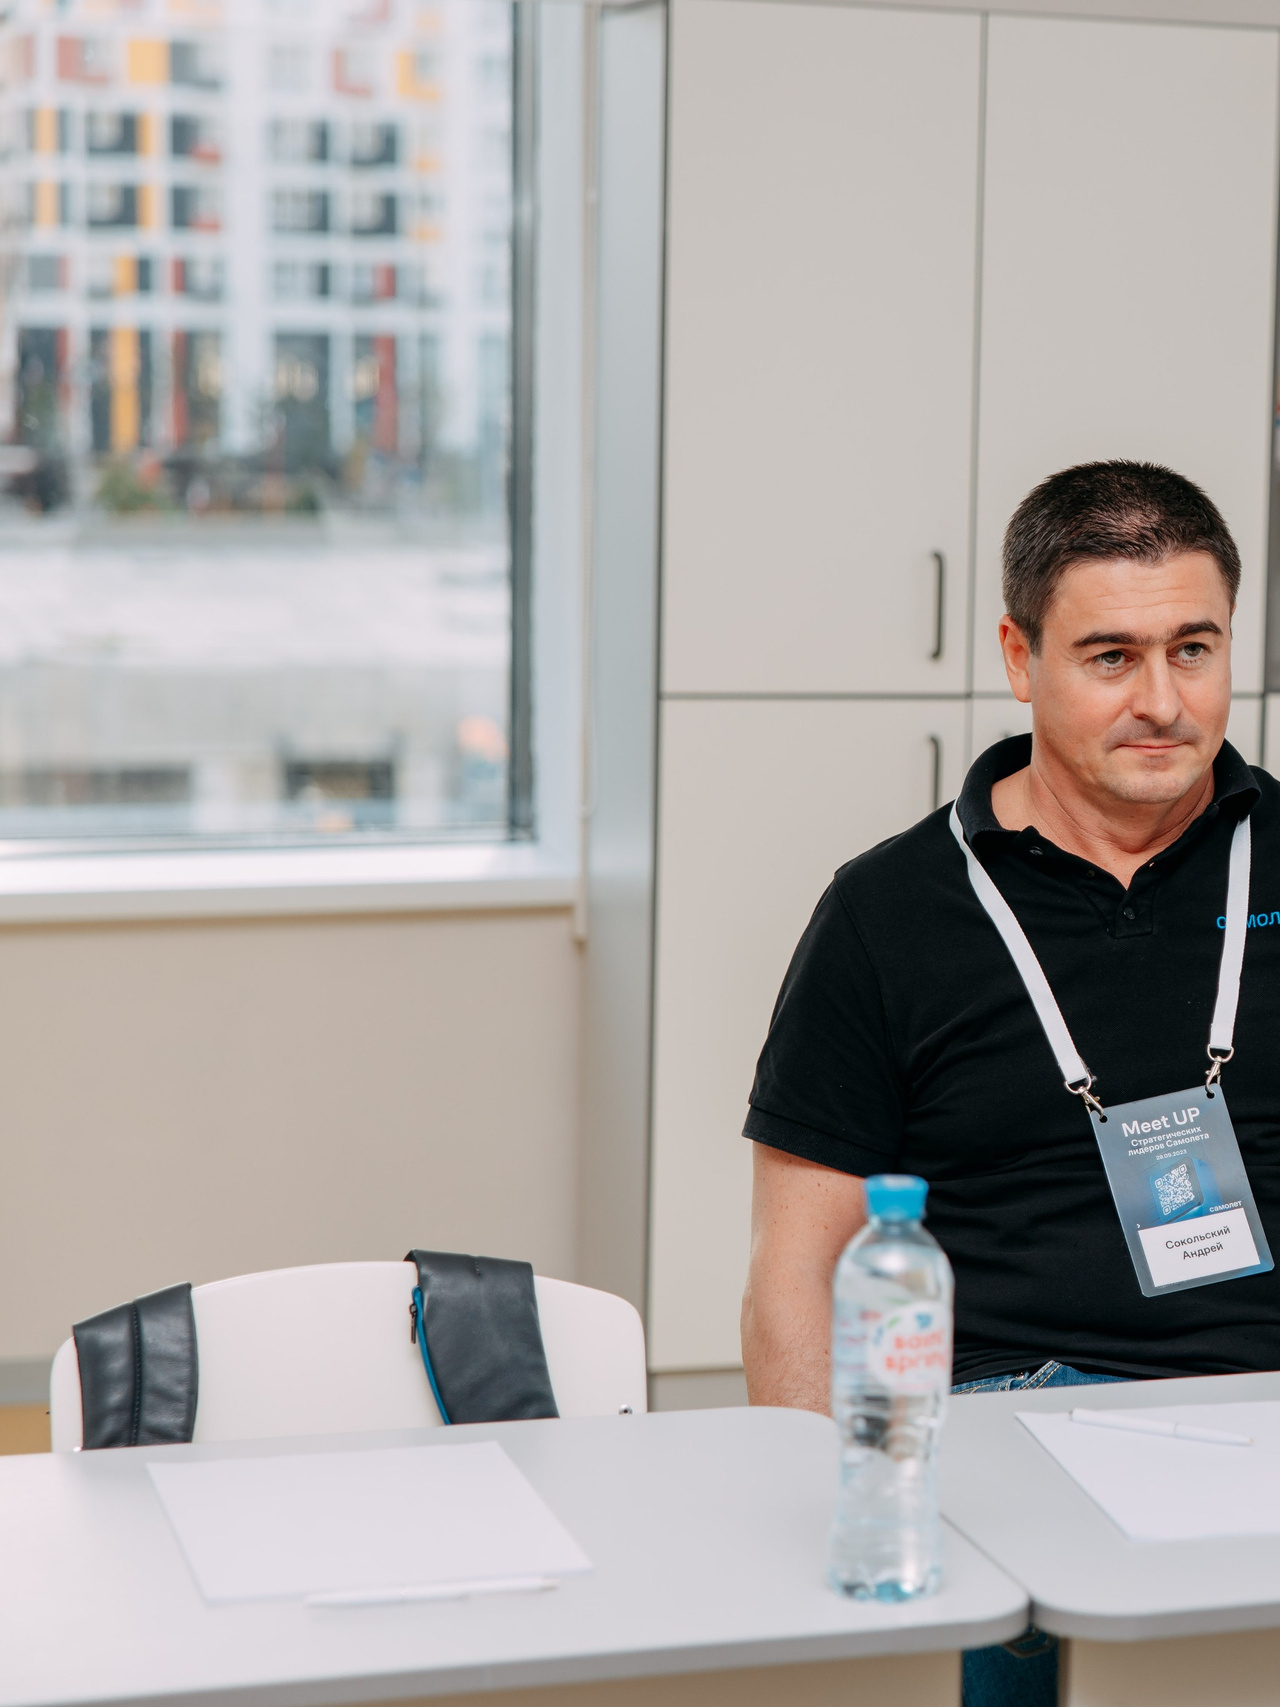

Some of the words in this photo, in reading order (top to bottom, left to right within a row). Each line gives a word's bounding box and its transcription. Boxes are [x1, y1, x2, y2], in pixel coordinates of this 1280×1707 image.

[1121, 1115, 1171, 1137] Meet
[1172, 1107, 1200, 1125] UP
[1128, 1142, 1165, 1156] лидеров
[1166, 1132, 1210, 1148] Самолета
[1131, 1126, 1202, 1147] Стратегических
[1209, 1200, 1242, 1213] самолет
[1165, 1225, 1231, 1249] Сокольский
[1183, 1242, 1224, 1260] Андрей
